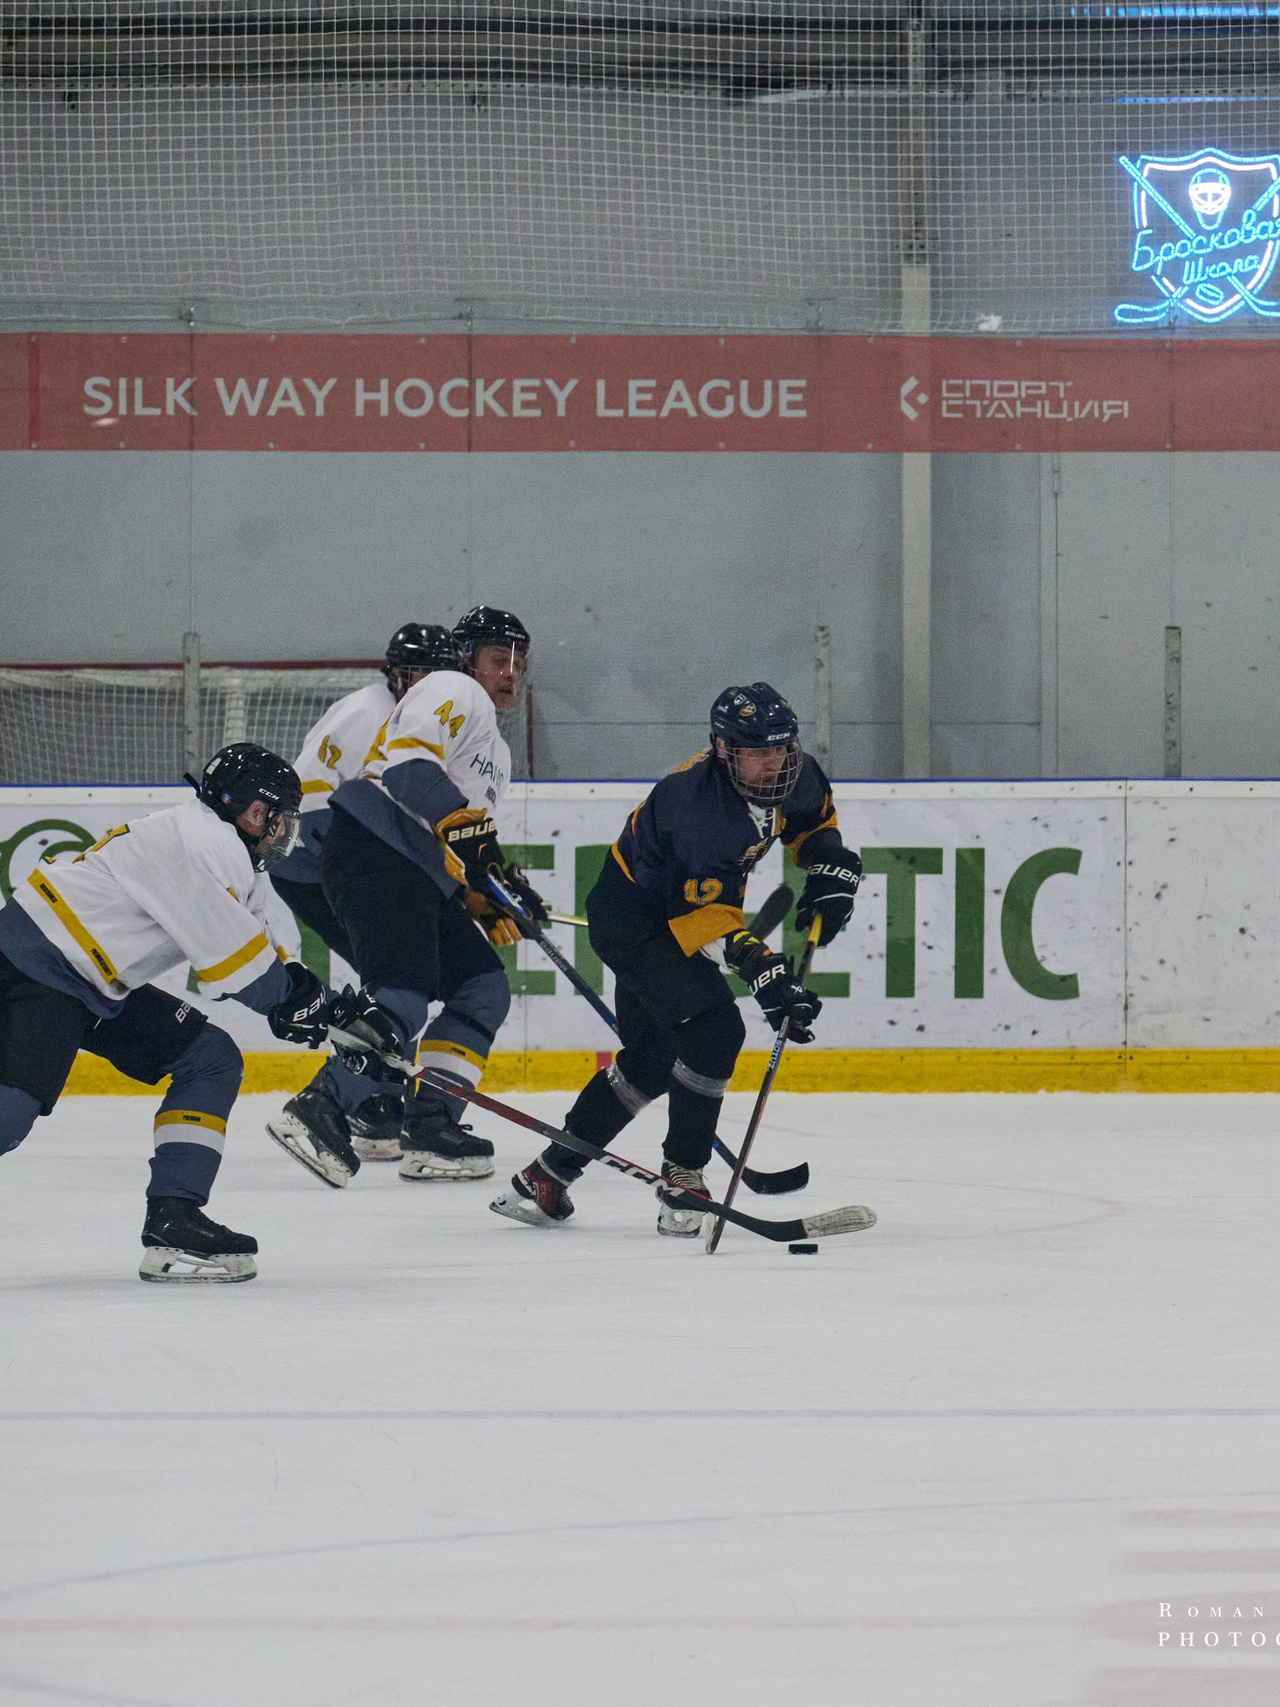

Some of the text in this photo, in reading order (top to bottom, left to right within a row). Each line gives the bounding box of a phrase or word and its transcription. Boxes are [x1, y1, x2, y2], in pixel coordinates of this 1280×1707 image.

[1183, 255, 1260, 284] Школа
[84, 376, 807, 419] SILK WAY HOCKEY LEAGUE
[942, 379, 1073, 398] СПОРТ
[942, 399, 1129, 422] СТАНЦИЯ
[433, 699, 466, 738] 44
[766, 732, 791, 741] CCM
[258, 787, 280, 801] CCM
[600, 1154, 687, 1198] CCM
